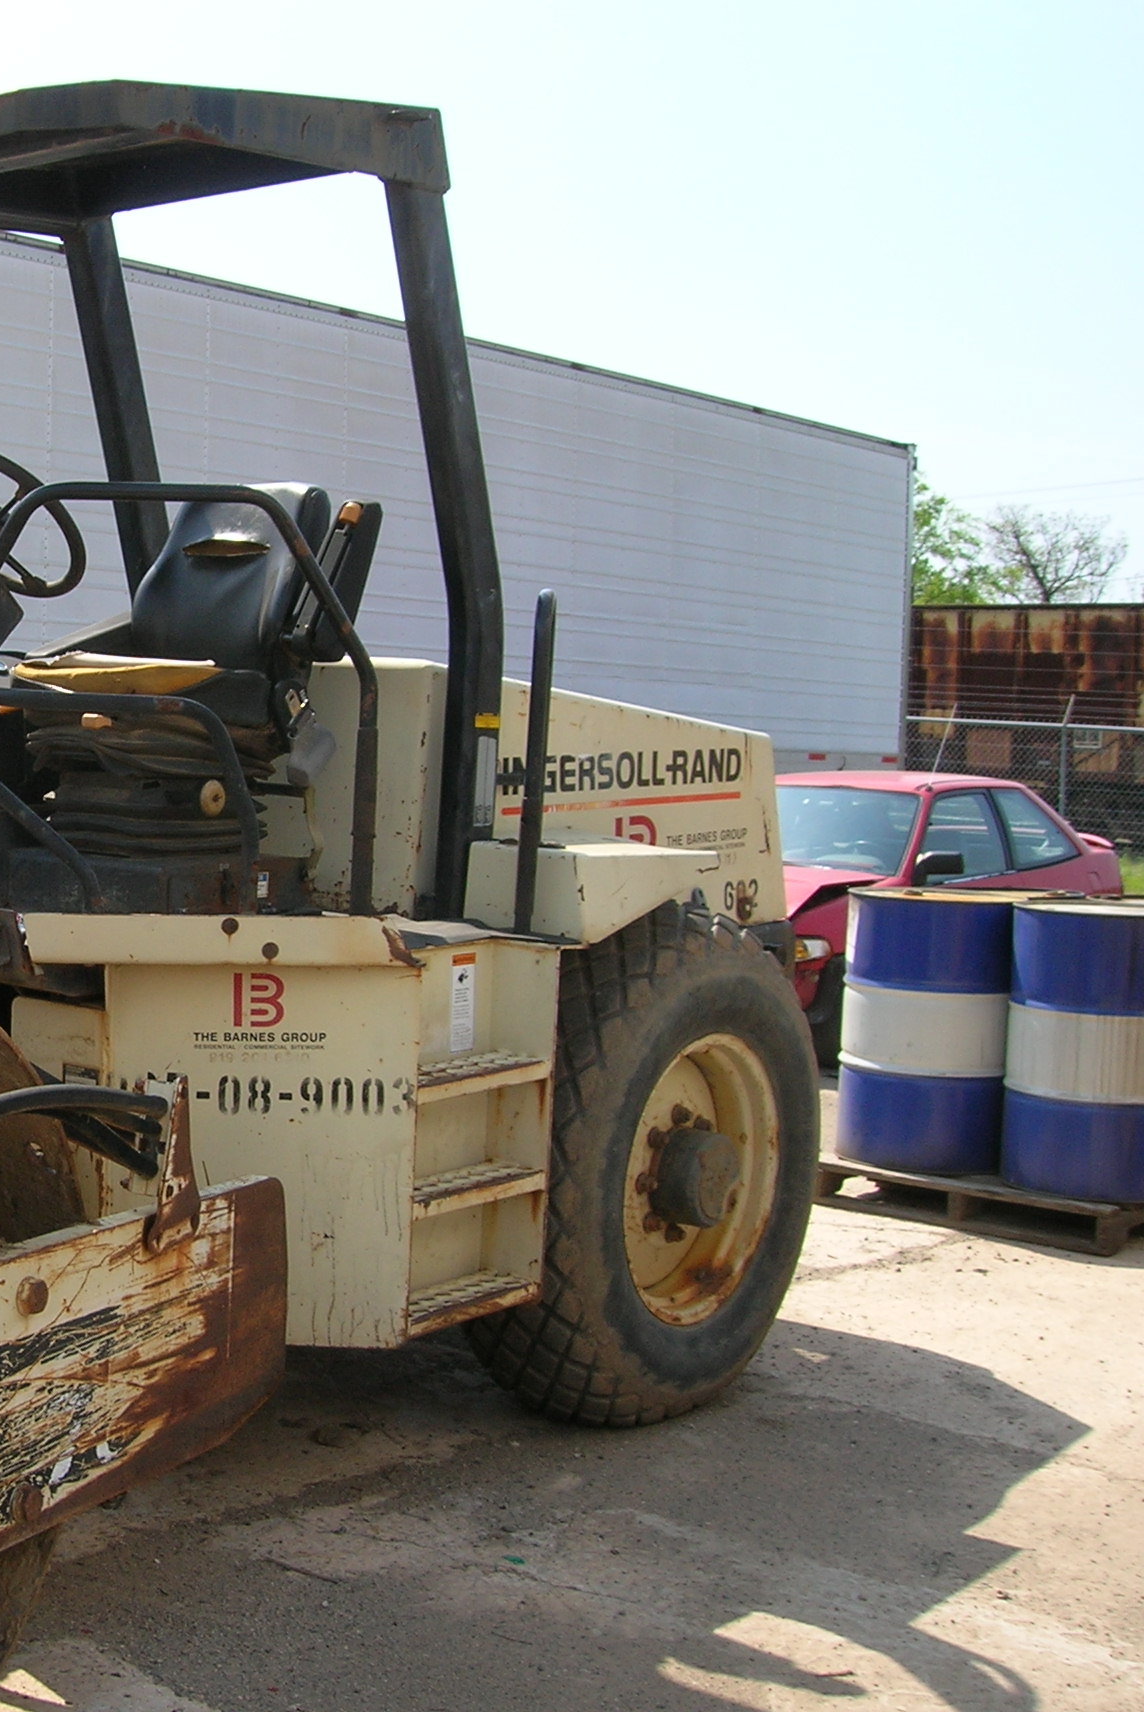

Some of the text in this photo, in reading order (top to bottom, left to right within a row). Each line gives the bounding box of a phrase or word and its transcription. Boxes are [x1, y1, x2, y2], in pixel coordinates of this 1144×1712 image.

[666, 834, 683, 847] THE
[686, 831, 717, 845] BARNES
[720, 827, 747, 841] GROUP
[193, 1032, 327, 1042] THE BARNES GROUP
